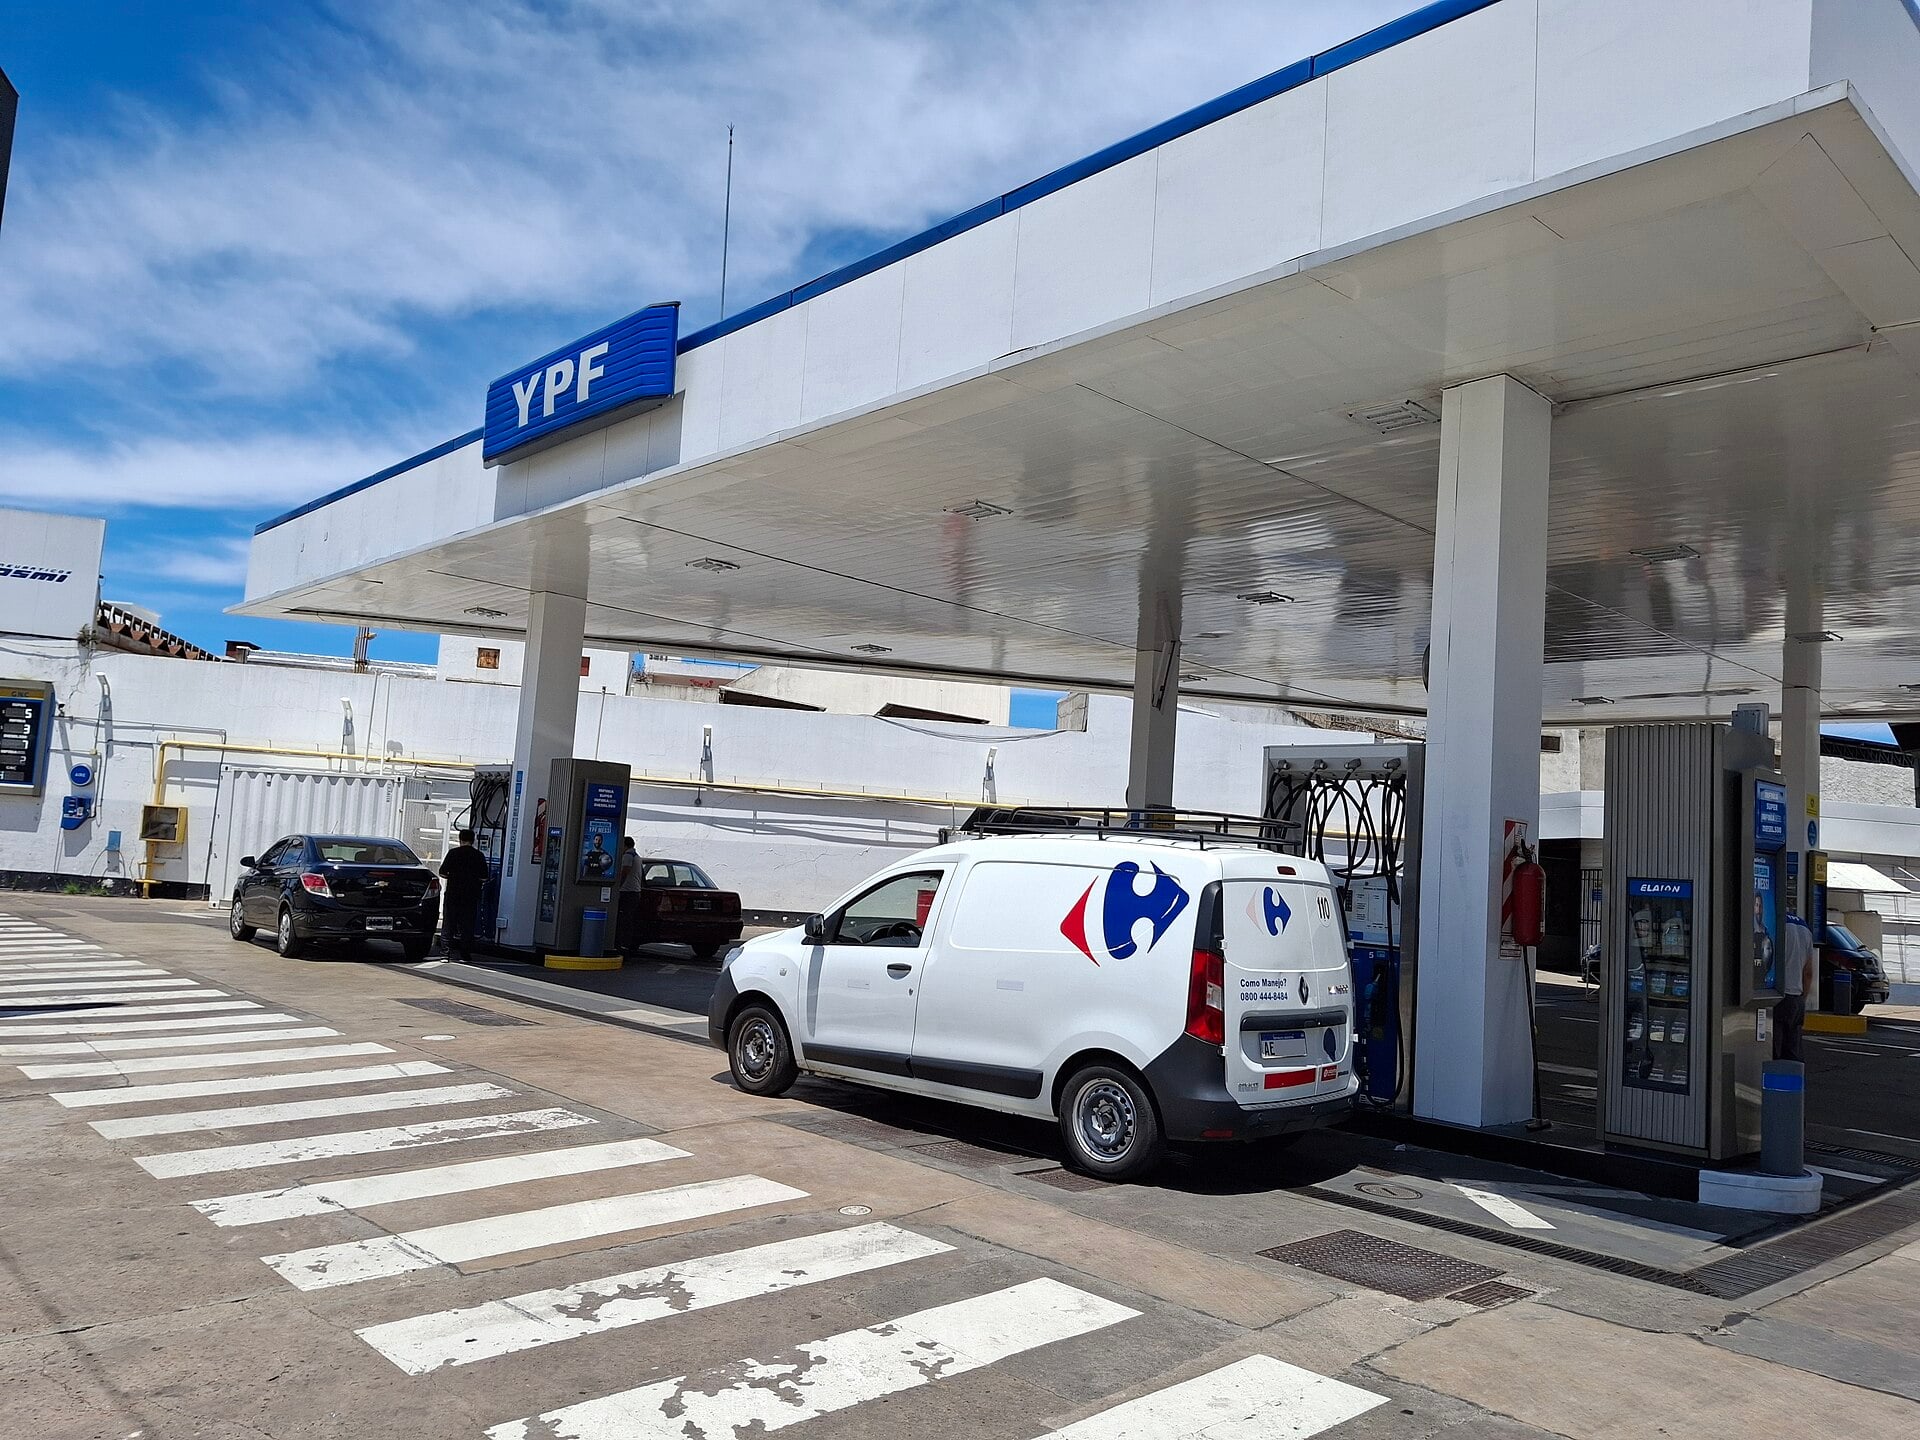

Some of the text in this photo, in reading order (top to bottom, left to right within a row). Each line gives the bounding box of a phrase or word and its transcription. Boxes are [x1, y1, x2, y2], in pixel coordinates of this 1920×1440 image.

[511, 341, 609, 428] YPF
[1640, 883, 1681, 893] ELAION
[1368, 951, 1375, 959] 5
[1240, 978, 1287, 989] Como Manejo?
[1240, 991, 1288, 1001] 0800 444-8484
[1264, 1041, 1276, 1056] AE
